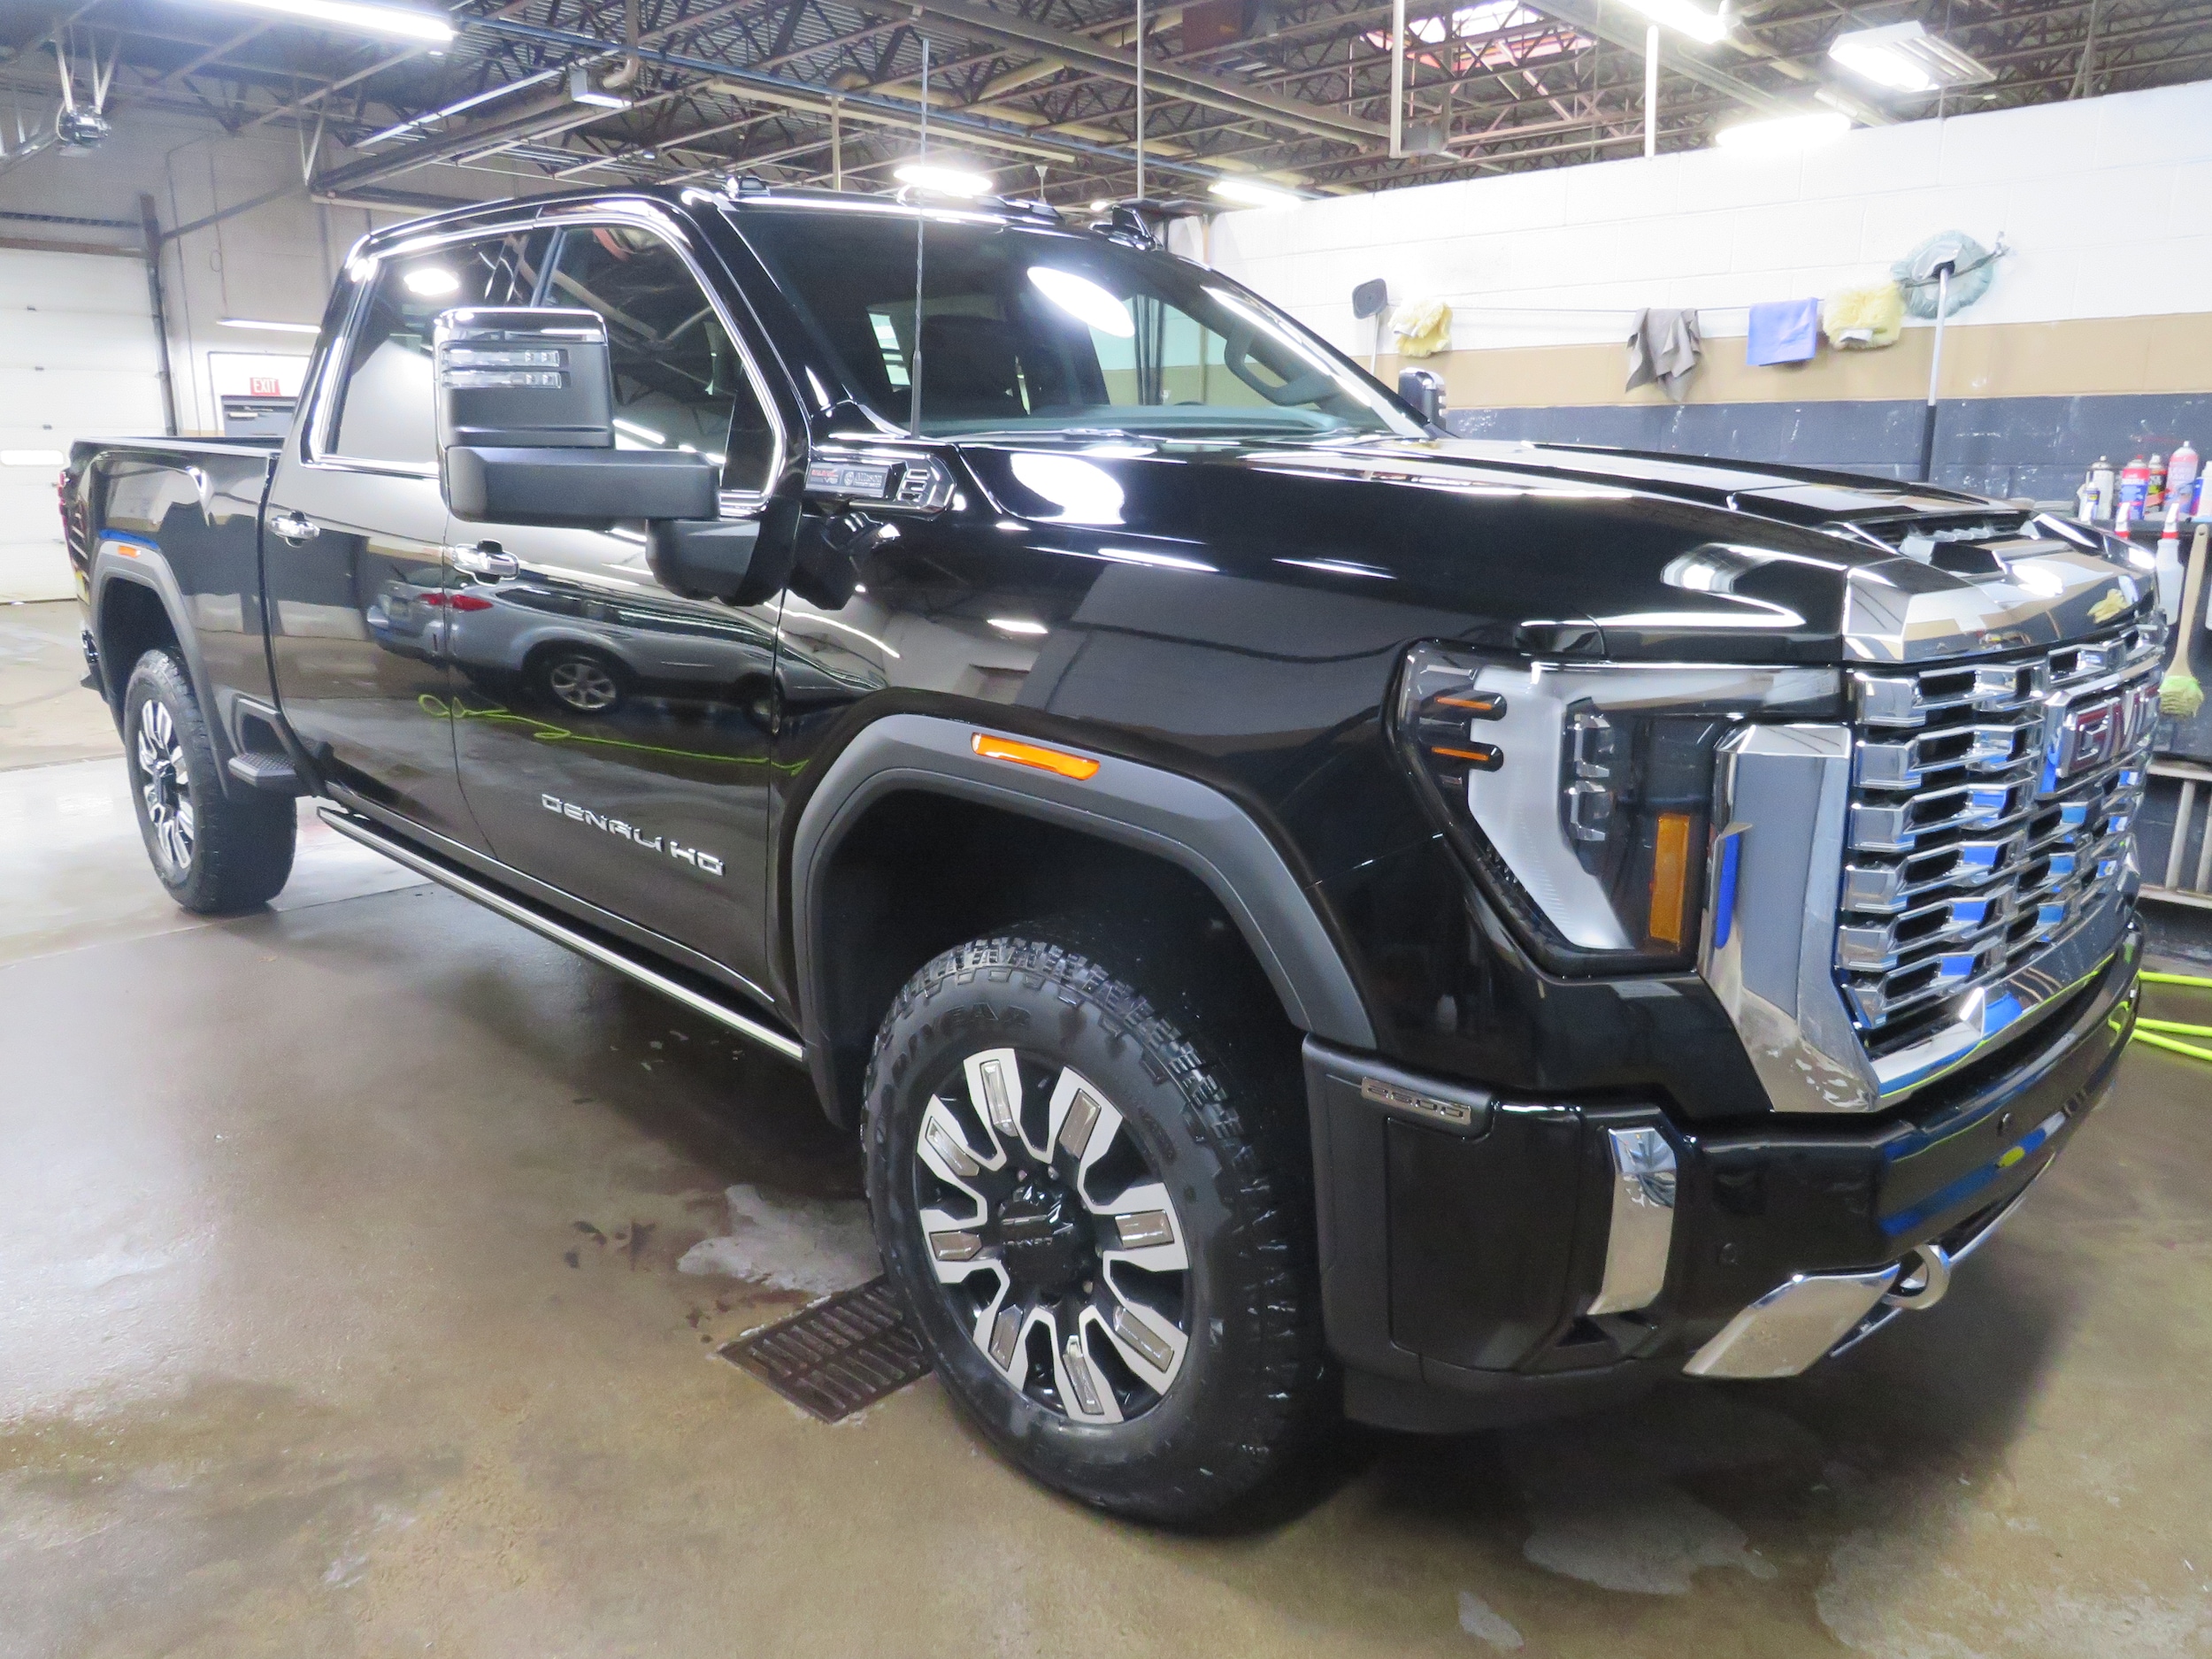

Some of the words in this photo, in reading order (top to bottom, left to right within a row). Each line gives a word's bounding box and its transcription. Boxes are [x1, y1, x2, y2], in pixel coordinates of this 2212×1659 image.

[253, 378, 276, 393] EXIT
[541, 793, 664, 852] DENALI
[670, 840, 726, 877] HD
